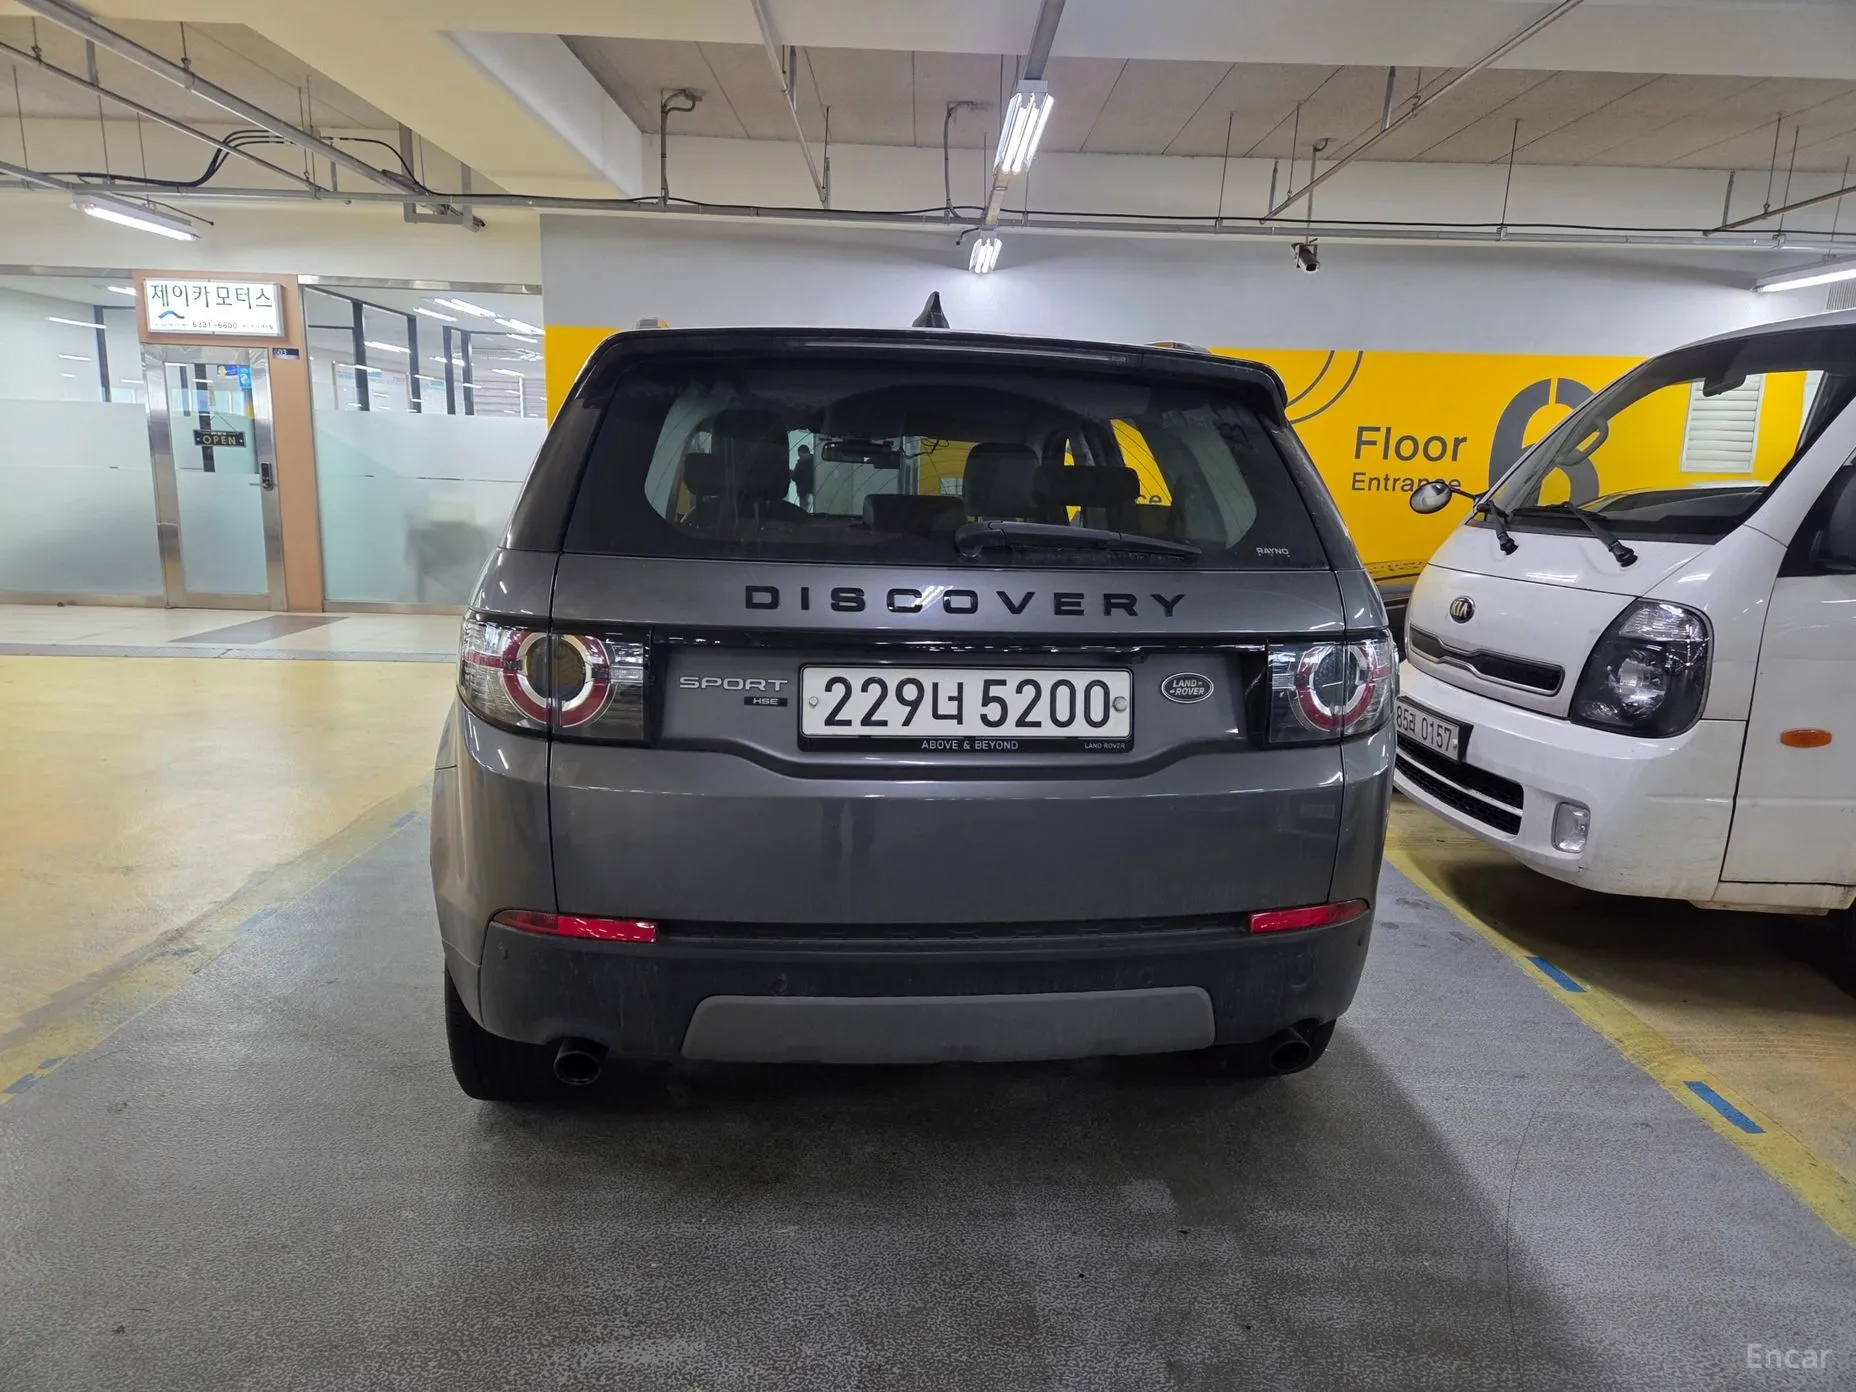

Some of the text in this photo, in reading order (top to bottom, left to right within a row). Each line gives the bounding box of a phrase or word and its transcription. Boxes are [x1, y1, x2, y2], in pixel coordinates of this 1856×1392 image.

[202, 435, 237, 445] OPEN
[1354, 426, 1468, 462] Floor
[1256, 547, 1290, 555] RAYNO
[745, 585, 1186, 617] DISCOVERY
[1451, 600, 1469, 618] KIA
[679, 676, 788, 691] SPORT
[752, 697, 779, 706] HSE
[824, 676, 1111, 729] 229너 5200
[1421, 716, 1452, 752] 0157
[921, 740, 1019, 750] ABOVE & BEYOND
